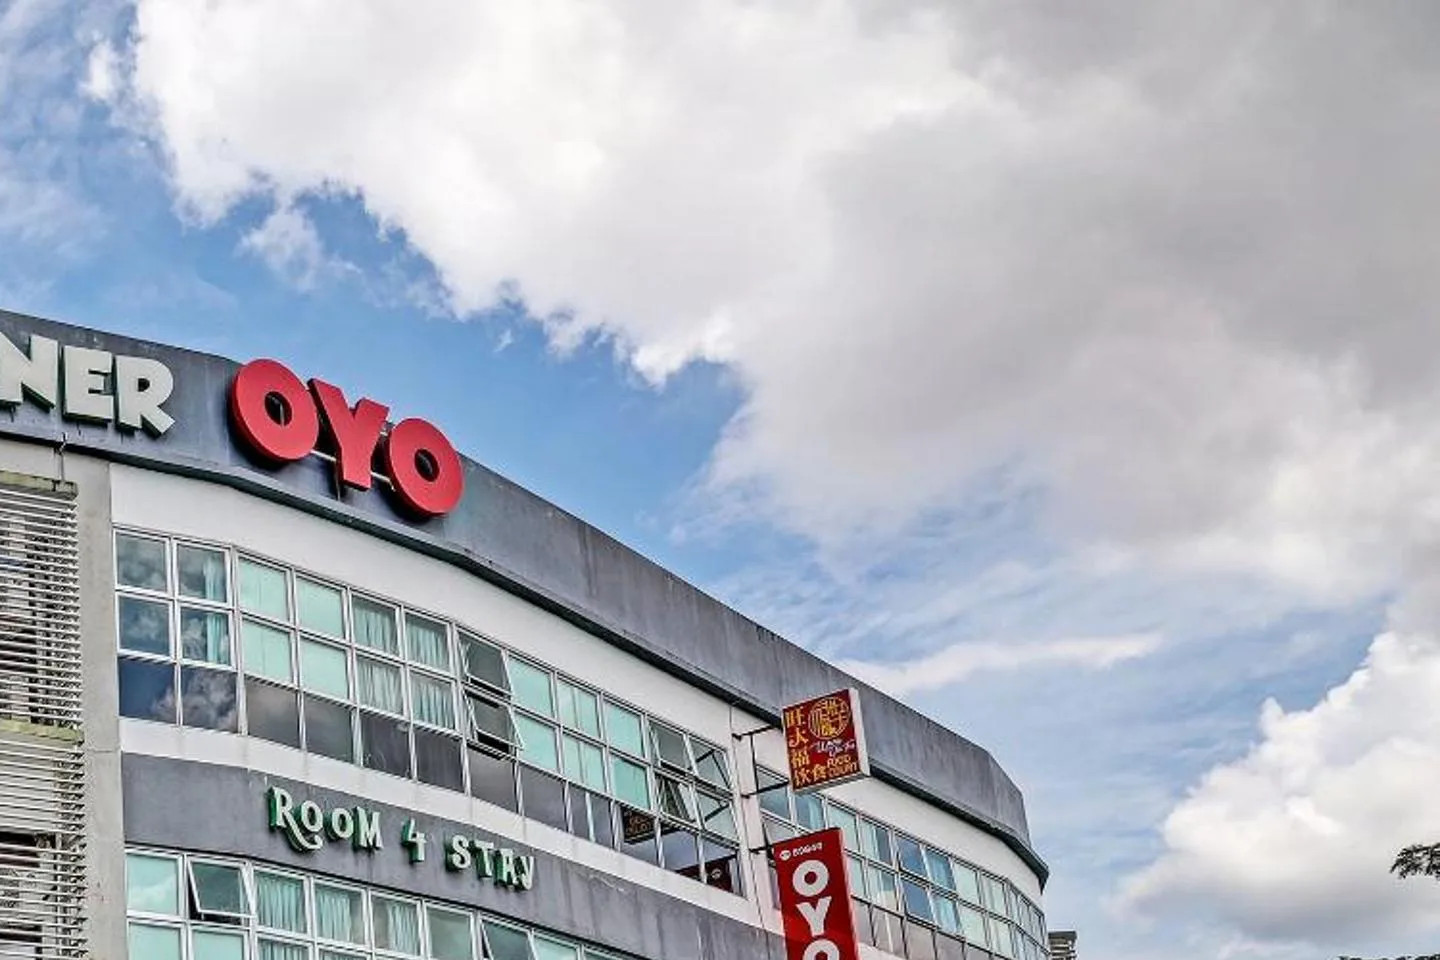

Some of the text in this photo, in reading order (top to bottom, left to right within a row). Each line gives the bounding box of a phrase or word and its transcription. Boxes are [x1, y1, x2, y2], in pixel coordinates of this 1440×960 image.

[229, 357, 464, 517] OYO
[268, 785, 536, 891] ROOM 4 STAY
